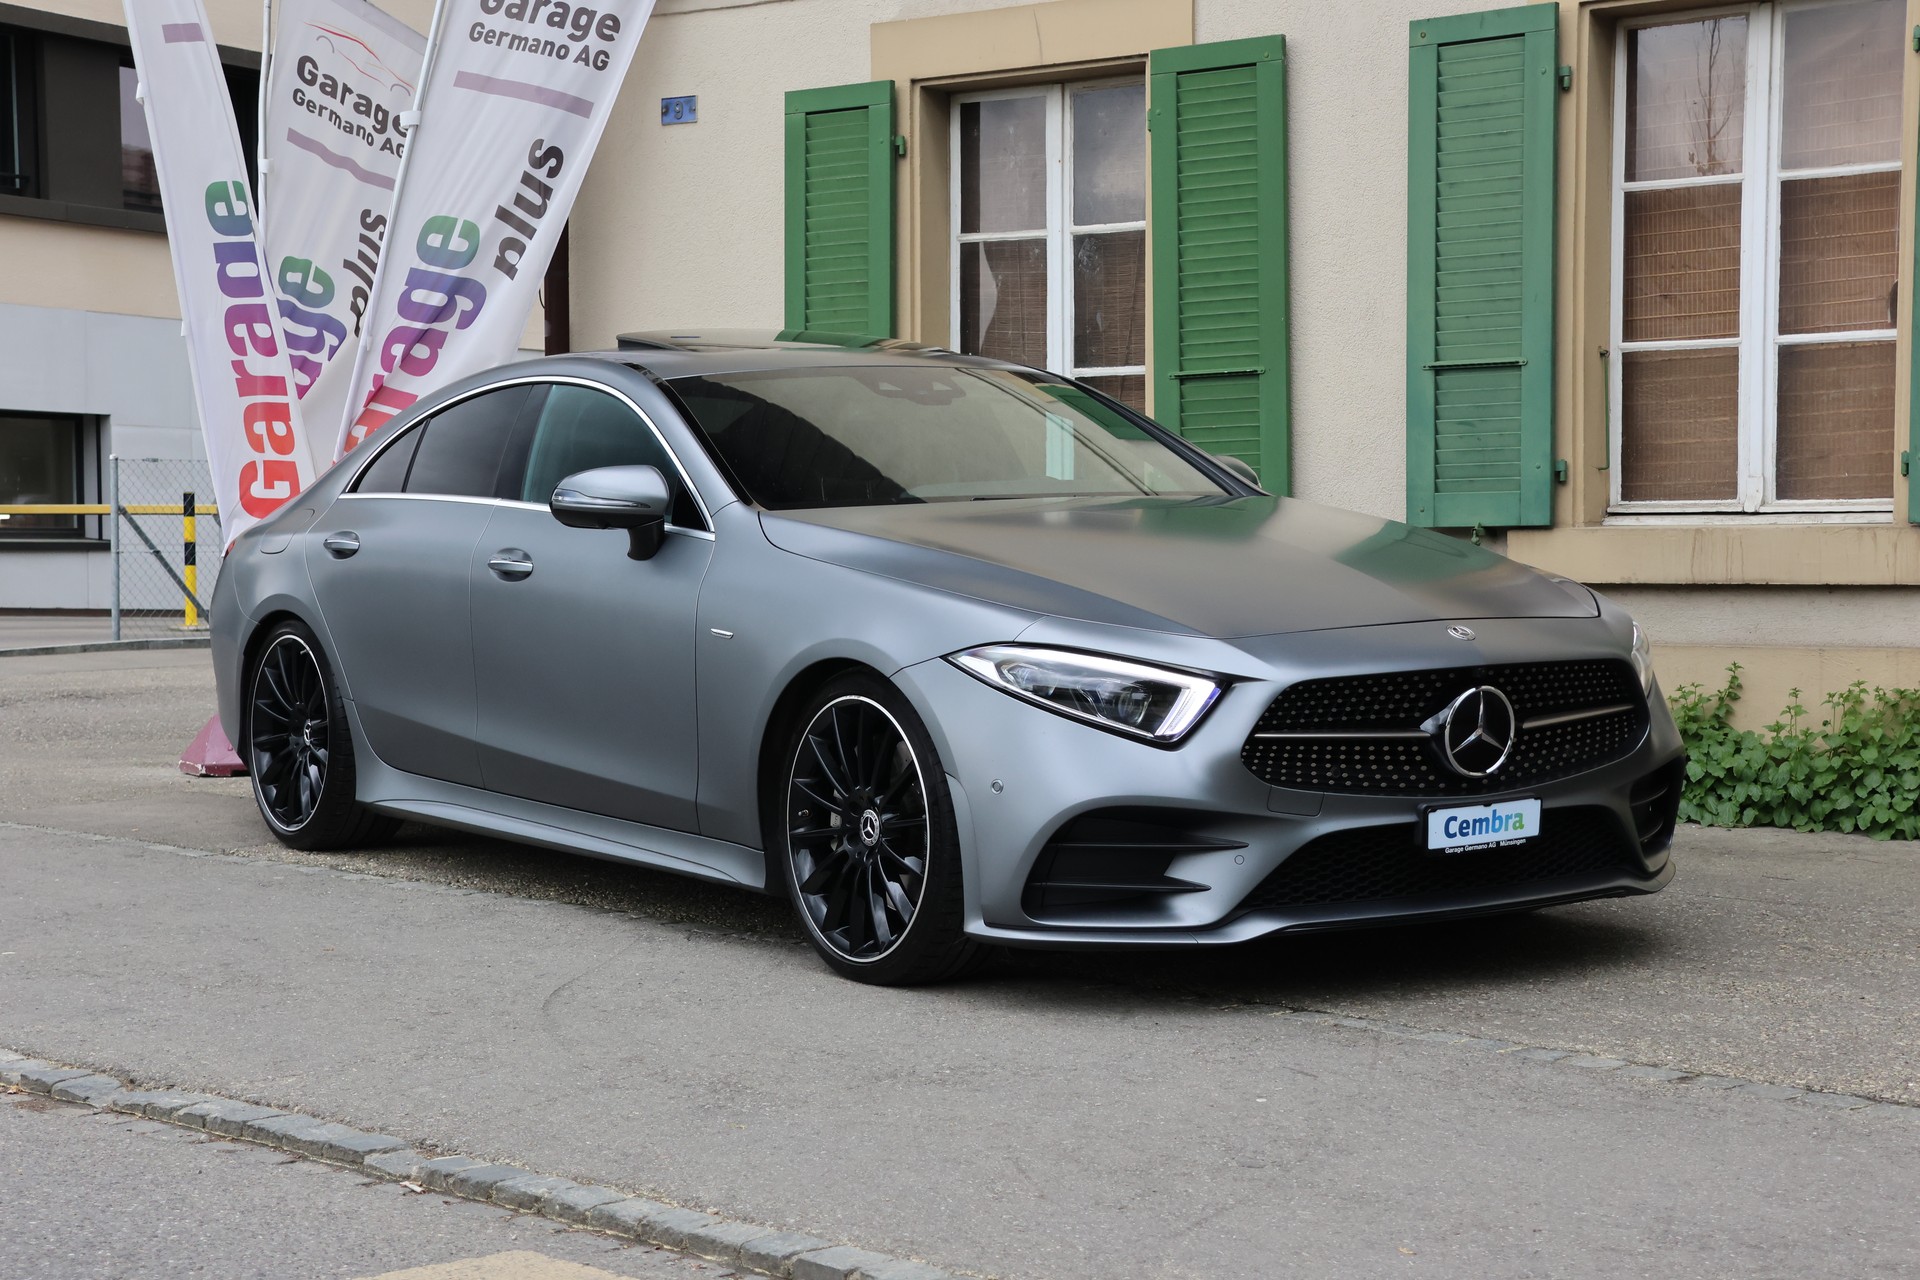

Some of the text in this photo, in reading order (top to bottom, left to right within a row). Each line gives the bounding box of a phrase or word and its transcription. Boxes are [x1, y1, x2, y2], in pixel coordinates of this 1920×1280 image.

[469, 22, 610, 71] Germano AG
[292, 88, 375, 147] Germano
[674, 101, 684, 120] 9
[493, 138, 564, 281] plus
[204, 180, 301, 520] Garage
[1444, 809, 1524, 838] Cembra
